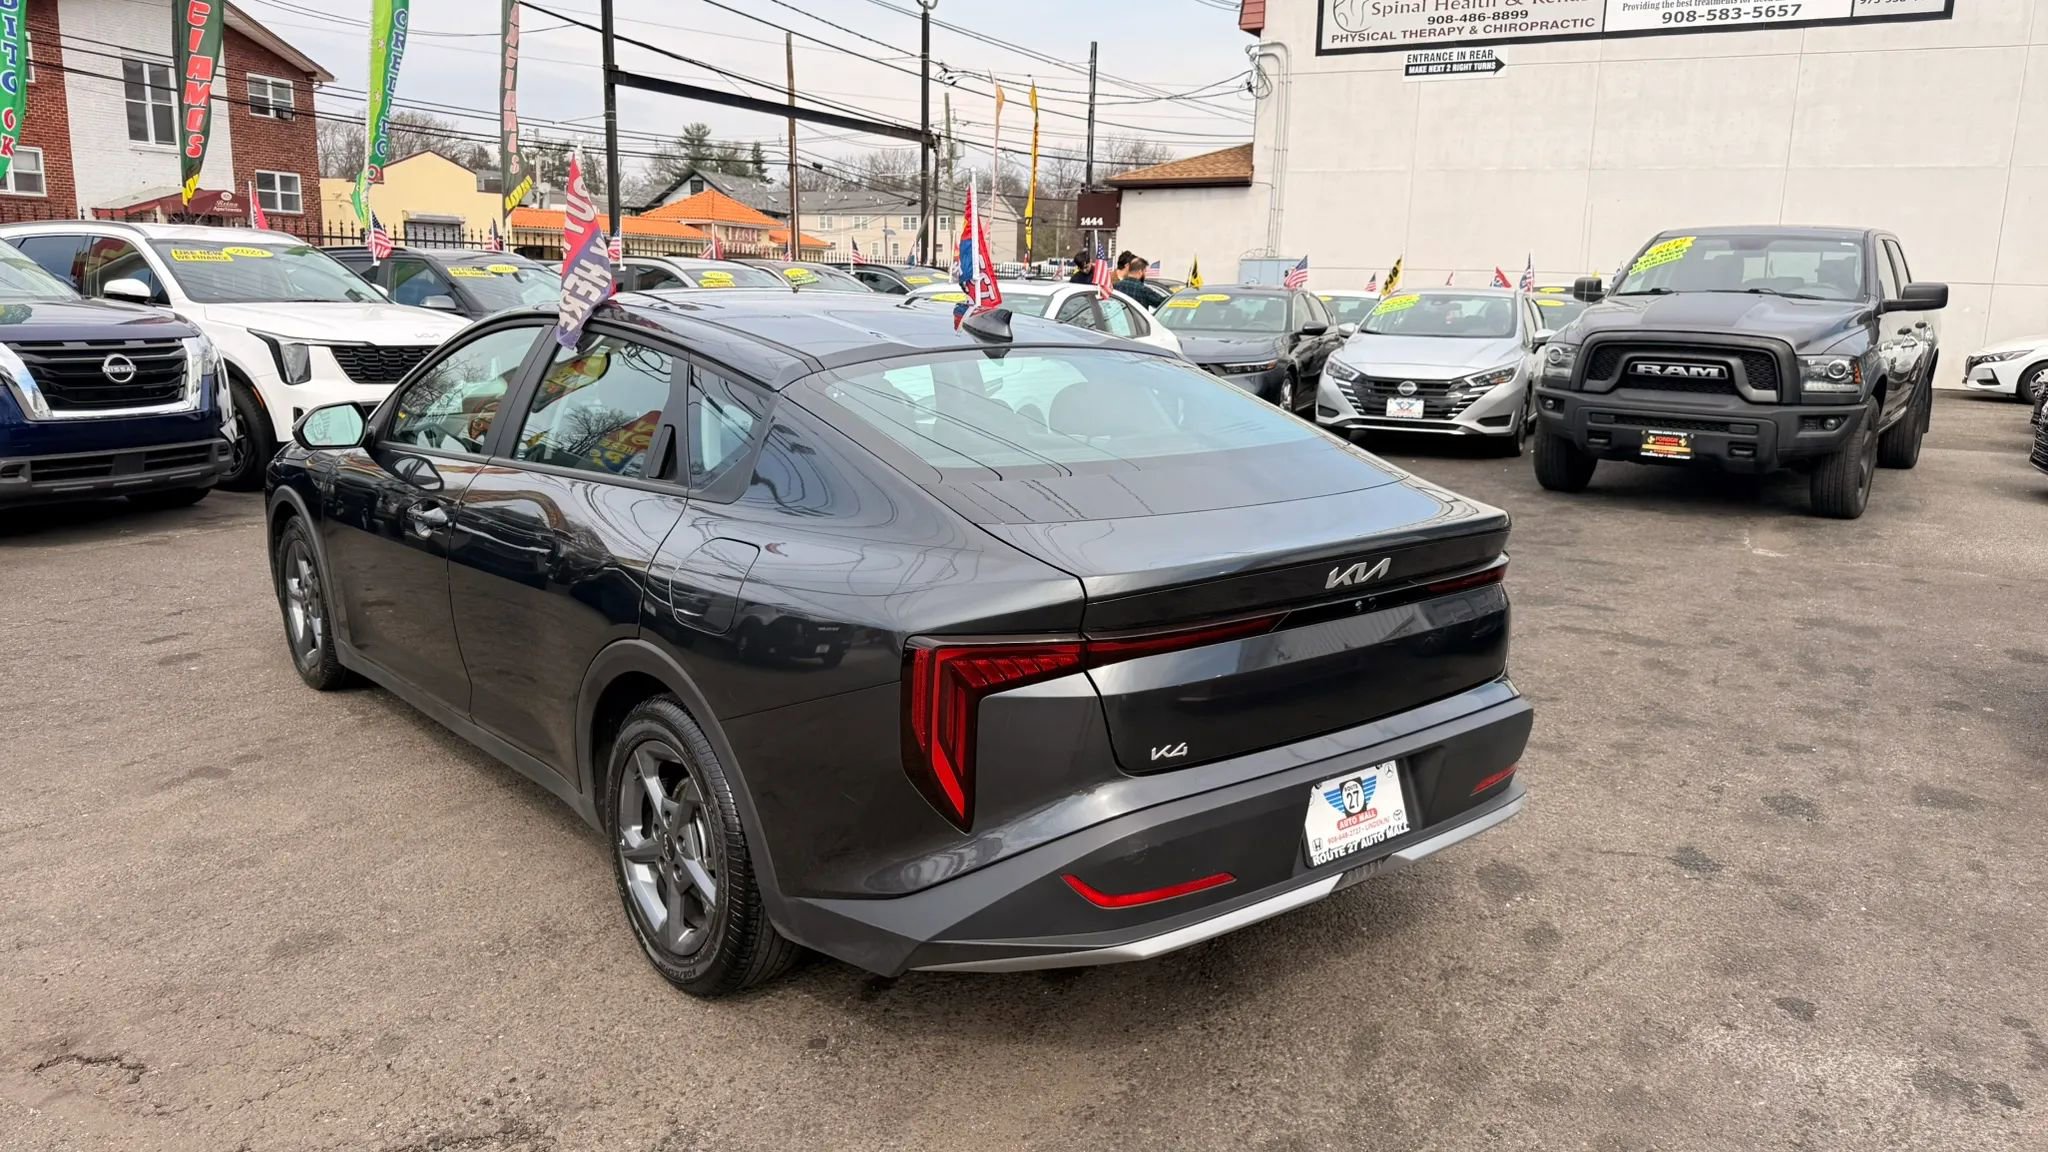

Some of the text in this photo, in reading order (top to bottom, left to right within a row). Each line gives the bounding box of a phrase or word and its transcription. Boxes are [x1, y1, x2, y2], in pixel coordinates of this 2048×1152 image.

[1371, 0, 1426, 17] Spinal
[1622, 1, 1660, 11] Providing
[1662, 0, 1674, 8] the
[1662, 4, 1802, 24] 908-583-5657
[1427, 10, 1529, 25] 908-486-8899
[1331, 17, 1596, 43] PHYSICAL THERAPY & CHIROPRACTIC
[1407, 49, 1494, 63] ENTRANCE IN REAR
[1409, 61, 1496, 74] MAKE NEXT 2 RIGHT TURNS
[1, 107, 17, 158] OK
[1080, 217, 1103, 226] 1444
[1636, 364, 1720, 377] RAM
[1325, 557, 1391, 589] KIA
[1151, 742, 1188, 761] K4
[1344, 783, 1359, 792] ROUTE
[1346, 790, 1360, 810] 27
[1339, 809, 1377, 830] AUTO MALL
[1312, 823, 1411, 867] ROUTE 27 AUTO MALL
